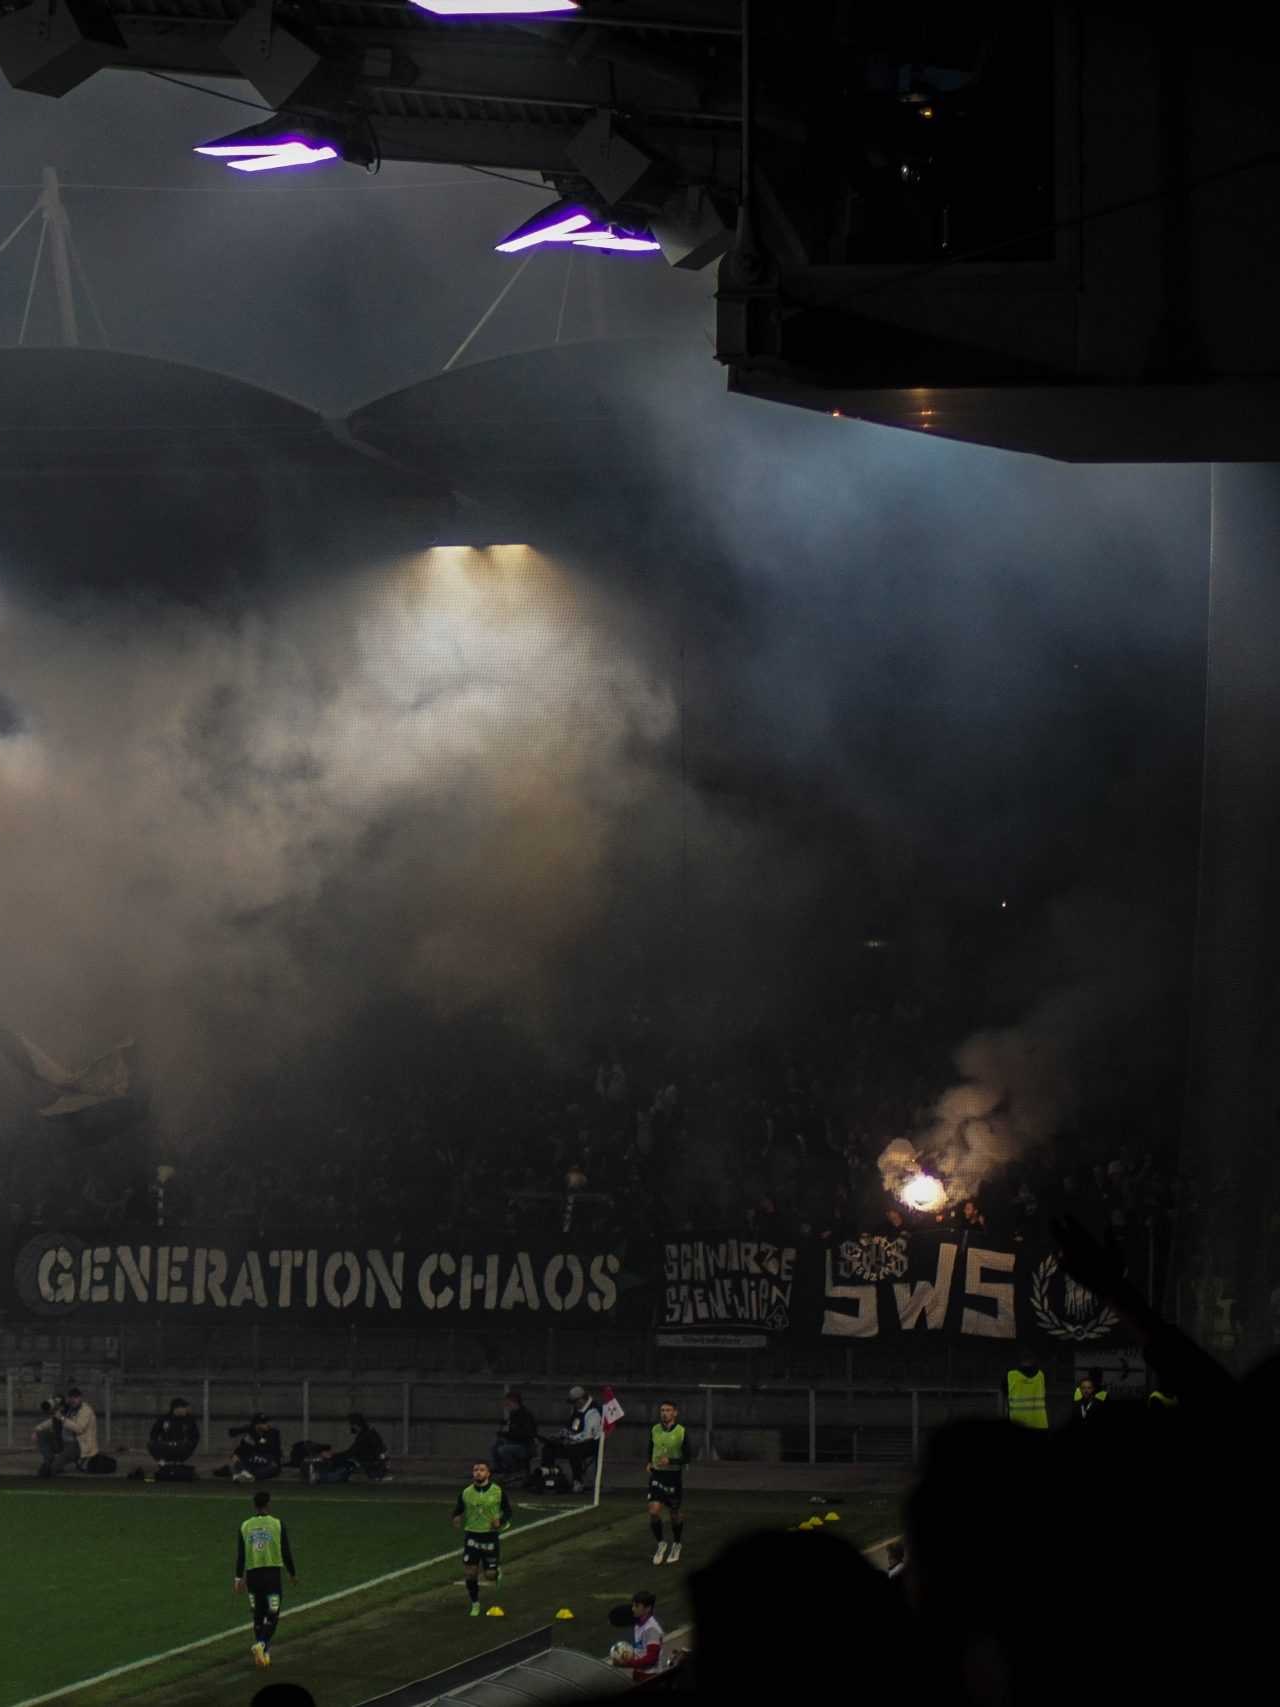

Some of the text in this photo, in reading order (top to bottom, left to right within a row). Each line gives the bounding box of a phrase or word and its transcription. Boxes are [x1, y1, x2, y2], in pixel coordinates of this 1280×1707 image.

[37, 1245, 621, 1313] GENERATION CHAOS
[664, 1239, 797, 1281] SCHWARZE
[821, 1242, 1017, 1339] SWS
